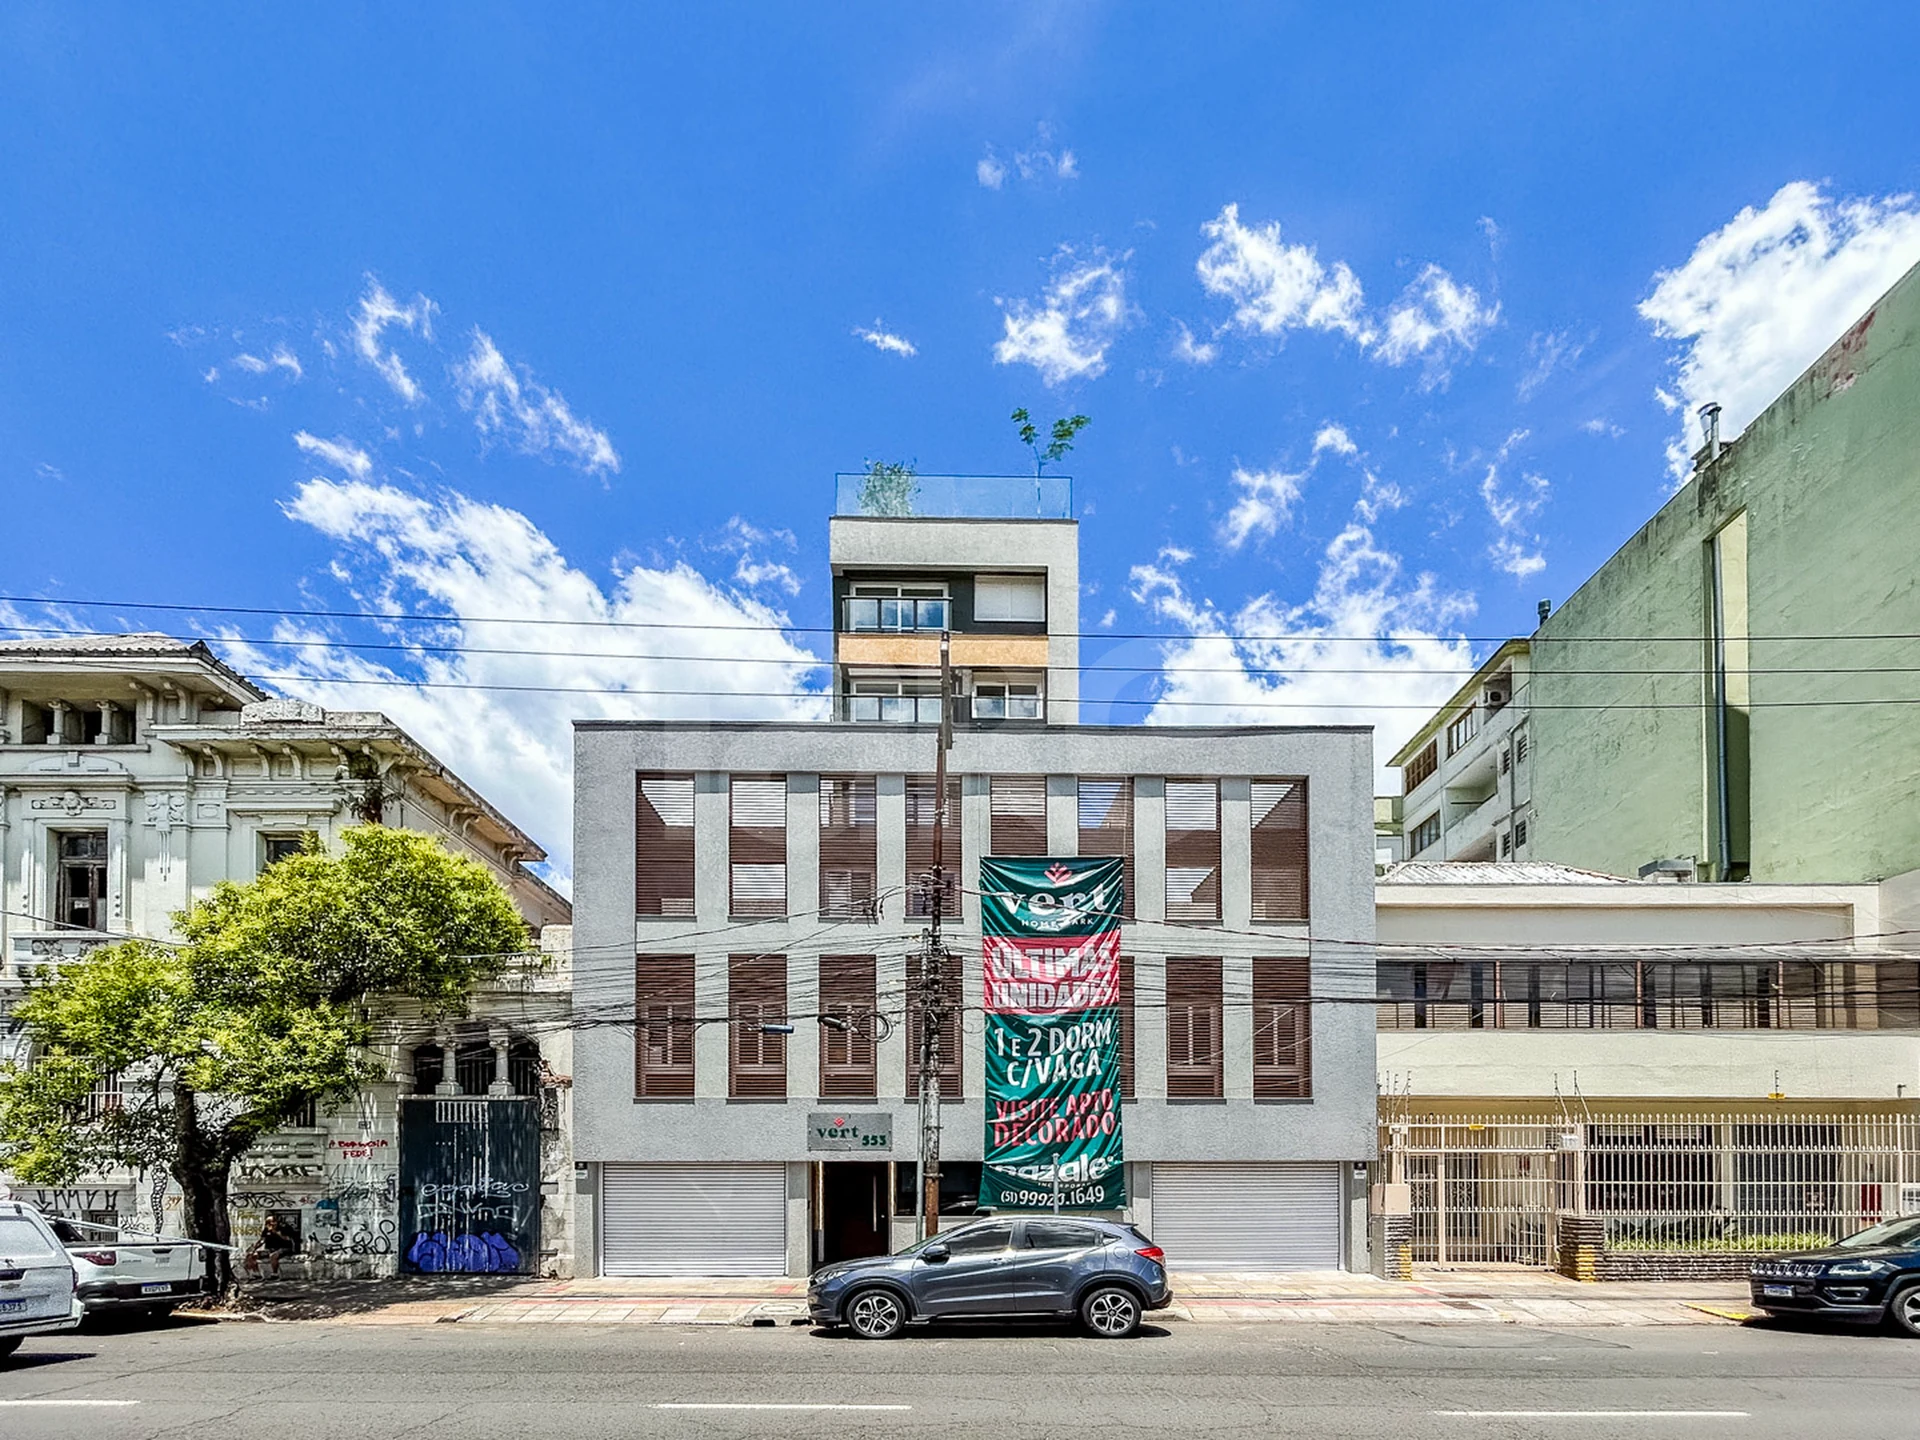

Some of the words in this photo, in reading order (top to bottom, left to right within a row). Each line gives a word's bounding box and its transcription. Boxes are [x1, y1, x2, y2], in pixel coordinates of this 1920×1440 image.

[1001, 884, 1108, 916] vert
[995, 1028, 1005, 1056] 1
[1012, 1038, 1021, 1057] E
[1028, 1028, 1042, 1056] 2
[1051, 1018, 1111, 1055] DORM
[1007, 1049, 1102, 1088] C/VAGA
[817, 1126, 859, 1138] vert
[994, 1112, 1115, 1147] DECORADO
